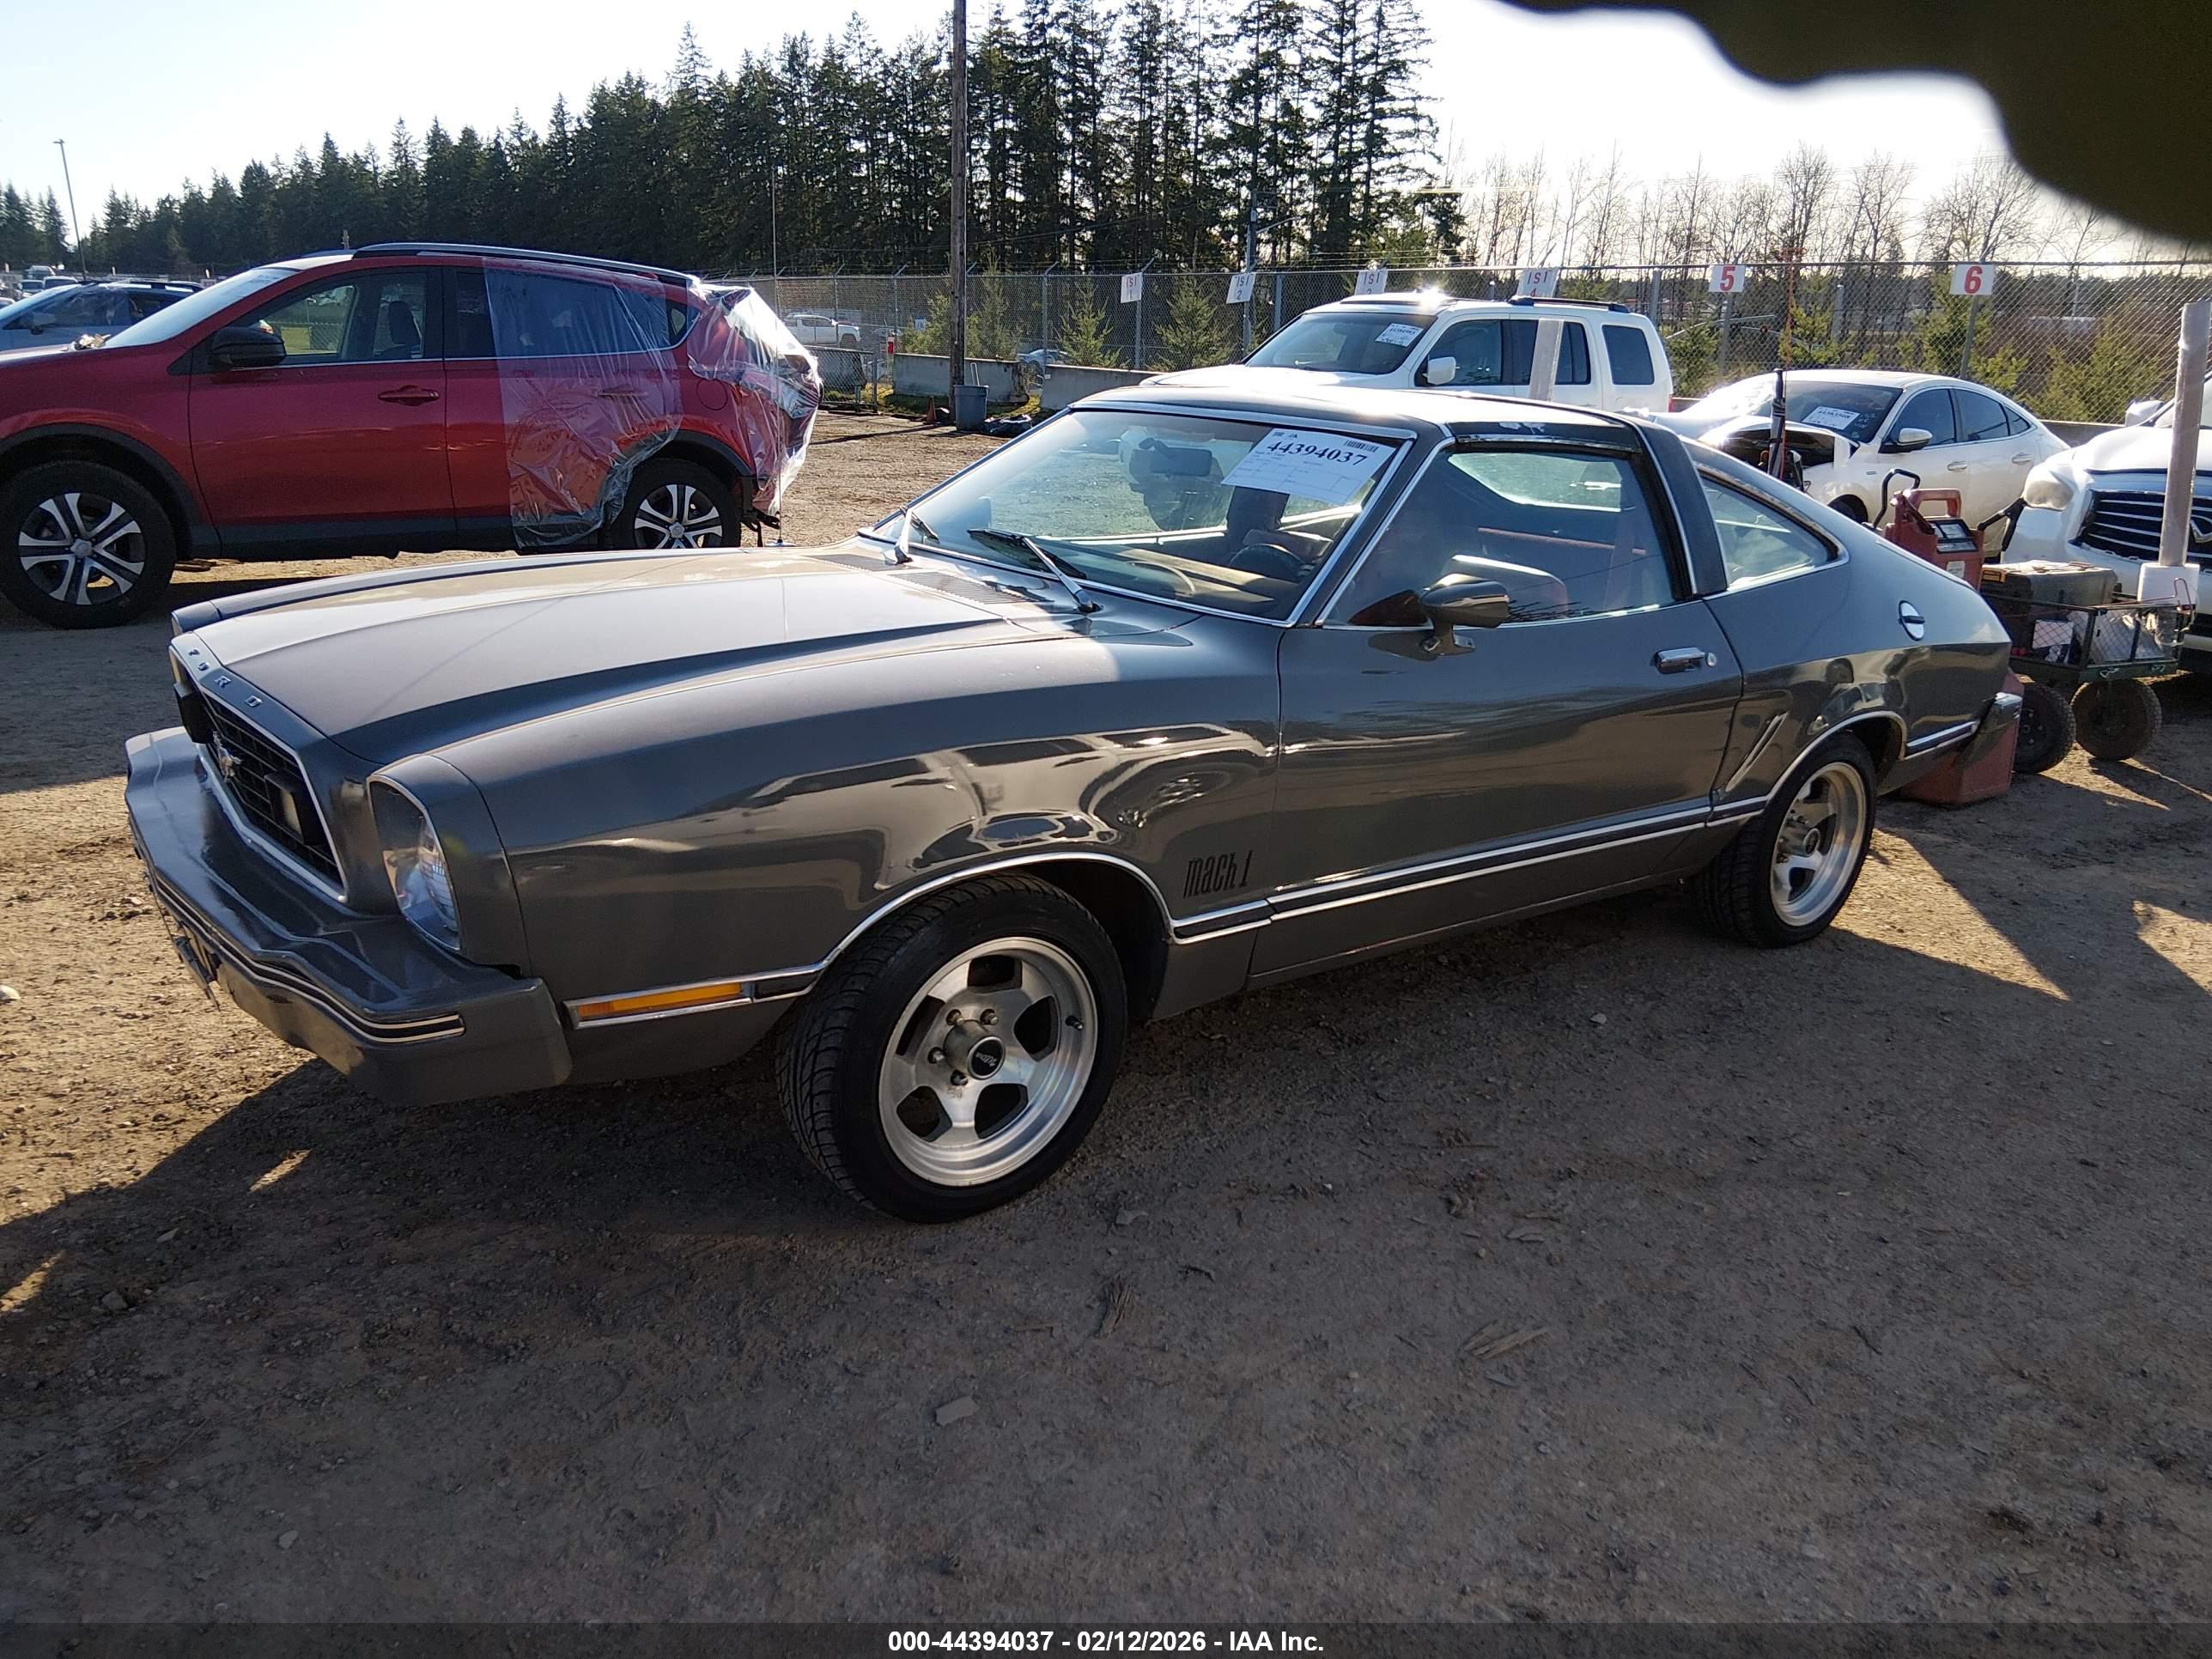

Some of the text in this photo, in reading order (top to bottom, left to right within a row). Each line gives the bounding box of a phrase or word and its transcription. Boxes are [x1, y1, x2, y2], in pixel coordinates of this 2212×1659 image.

[1719, 265, 1736, 291] 5
[1964, 265, 1983, 294] 6
[1237, 290, 1243, 301] 2
[1267, 441, 1368, 466] 44394037
[187, 647, 264, 708] FORD
[1239, 849, 1254, 887] 1
